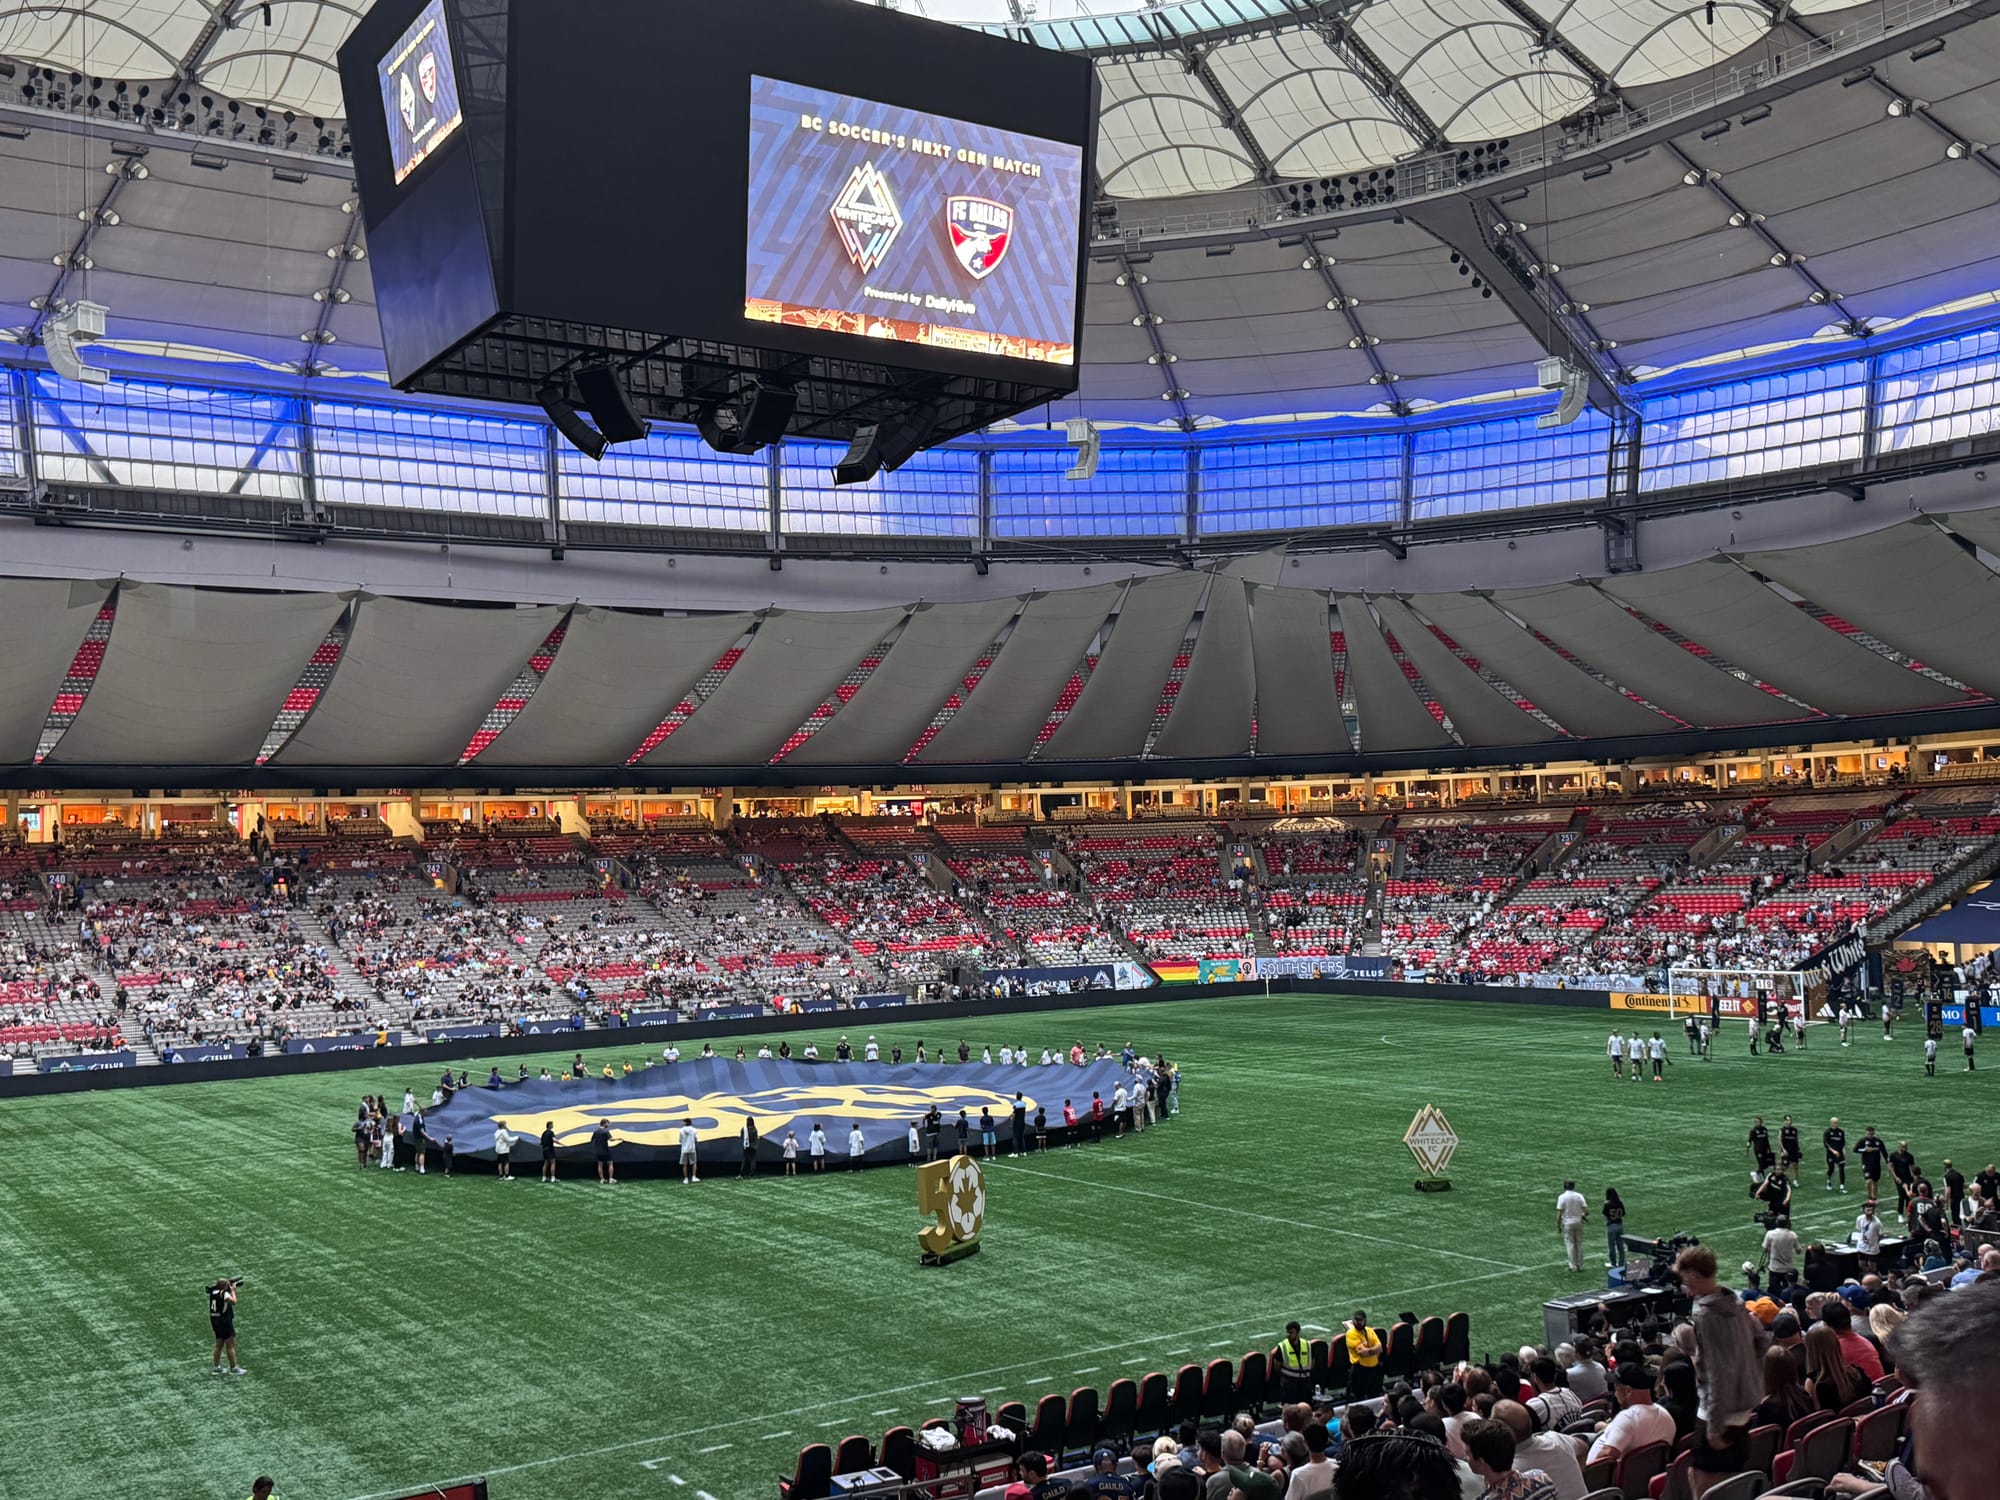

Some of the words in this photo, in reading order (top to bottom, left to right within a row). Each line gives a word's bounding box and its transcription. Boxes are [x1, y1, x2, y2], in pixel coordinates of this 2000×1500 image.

[801, 114, 823, 131] BC
[828, 120, 906, 149] SOCCER'S
[911, 138, 952, 159] NEXT
[958, 149, 988, 167] GEN
[993, 156, 1041, 178] MATCH
[835, 207, 895, 228] WHITECAPS
[952, 201, 967, 221] FC
[969, 202, 1008, 230] DALLAS
[858, 222, 872, 235] FC
[864, 286, 909, 302] Presented
[910, 293, 922, 306] by
[426, 864, 441, 873] 242
[50, 874, 66, 884] 240
[1828, 938, 1866, 974] White
[1260, 961, 1343, 975] SOUTHSIDERS
[1354, 969, 1385, 977] TELUS
[1625, 994, 1681, 1009] Continental
[211, 1053, 233, 1062] TELUS
[100, 1062, 124, 1070] TELUS
[1408, 1136, 1457, 1145] WHITECAPS
[1042, 1486, 1066, 1500] GAULD
[1098, 1482, 1125, 1491] GAULD
